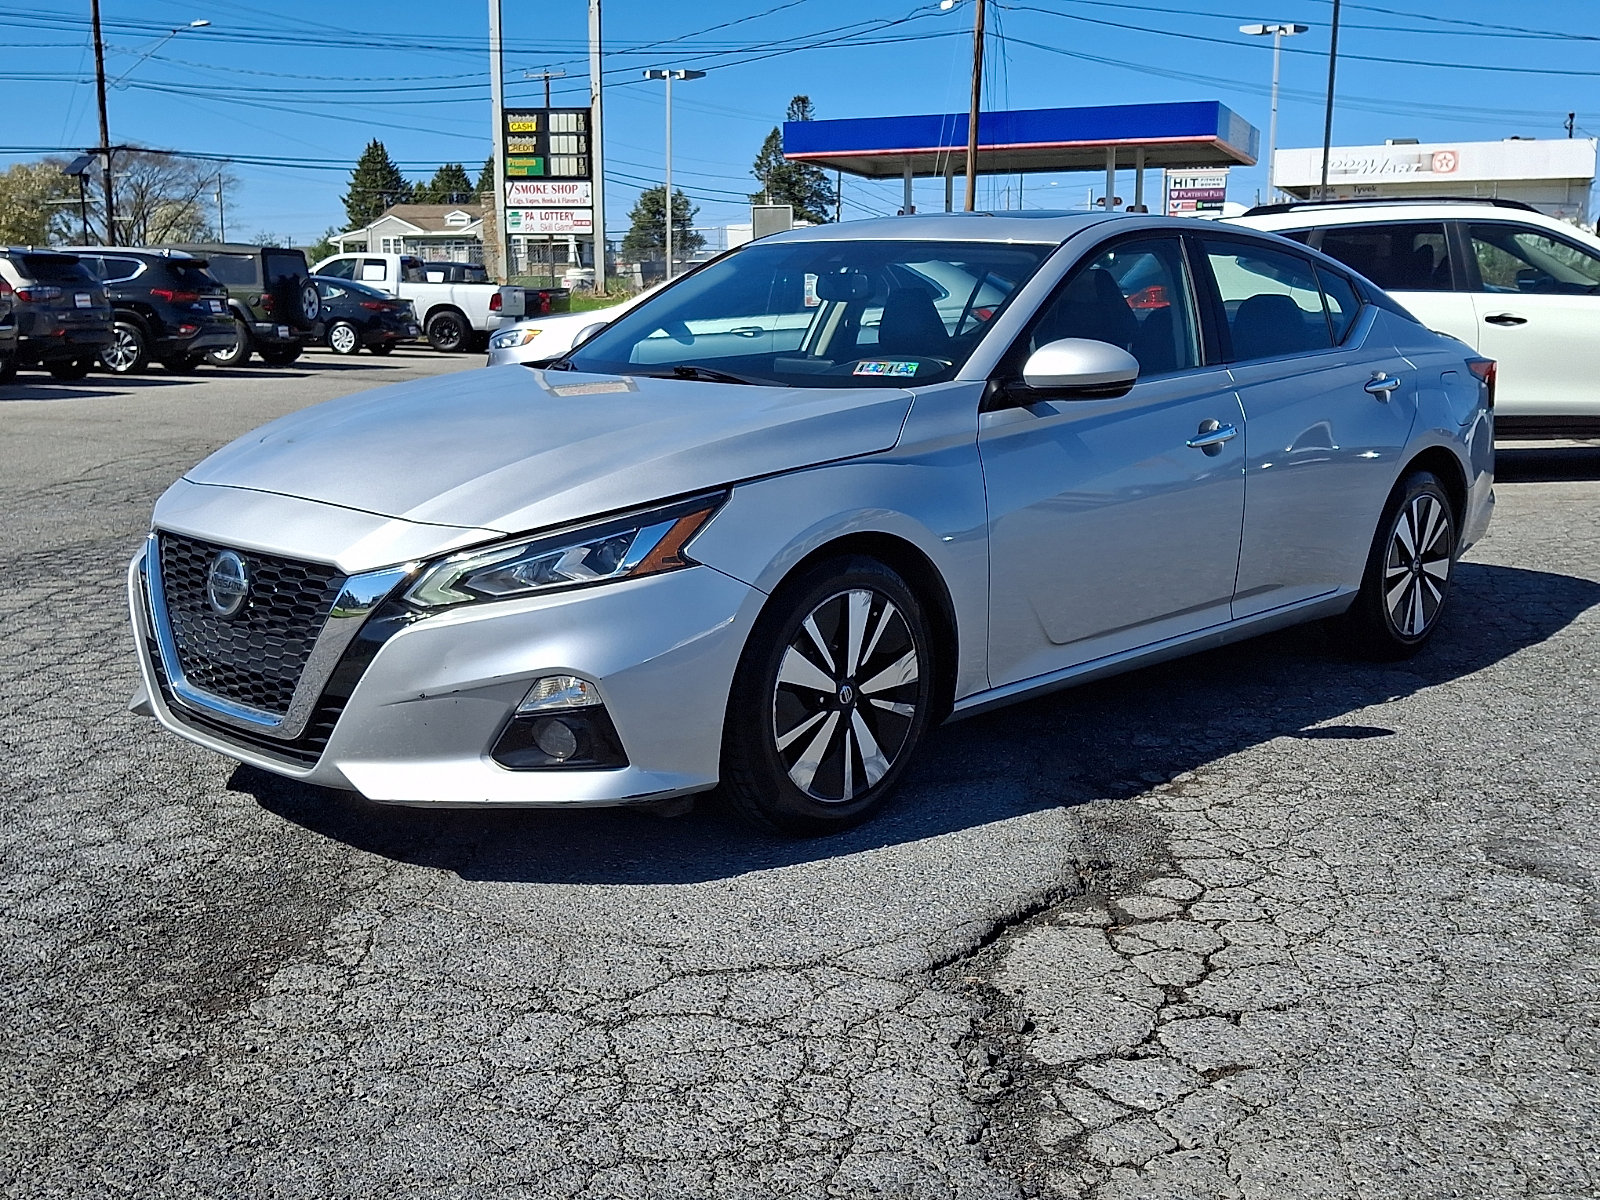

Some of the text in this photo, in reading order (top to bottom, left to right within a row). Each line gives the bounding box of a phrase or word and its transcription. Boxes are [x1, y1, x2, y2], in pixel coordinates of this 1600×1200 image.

[511, 123, 533, 131] CASH
[509, 144, 534, 152] CREDIT
[1174, 178, 1198, 188] HIT
[514, 184, 579, 194] SMOKE SHOP
[1312, 187, 1336, 196] Tyek
[1353, 185, 1378, 195] Tyvek
[1179, 190, 1209, 198] PLATINUM
[524, 211, 535, 221] PA
[539, 211, 575, 221] LOTTERY
[525, 223, 574, 232] PA Skill Game
